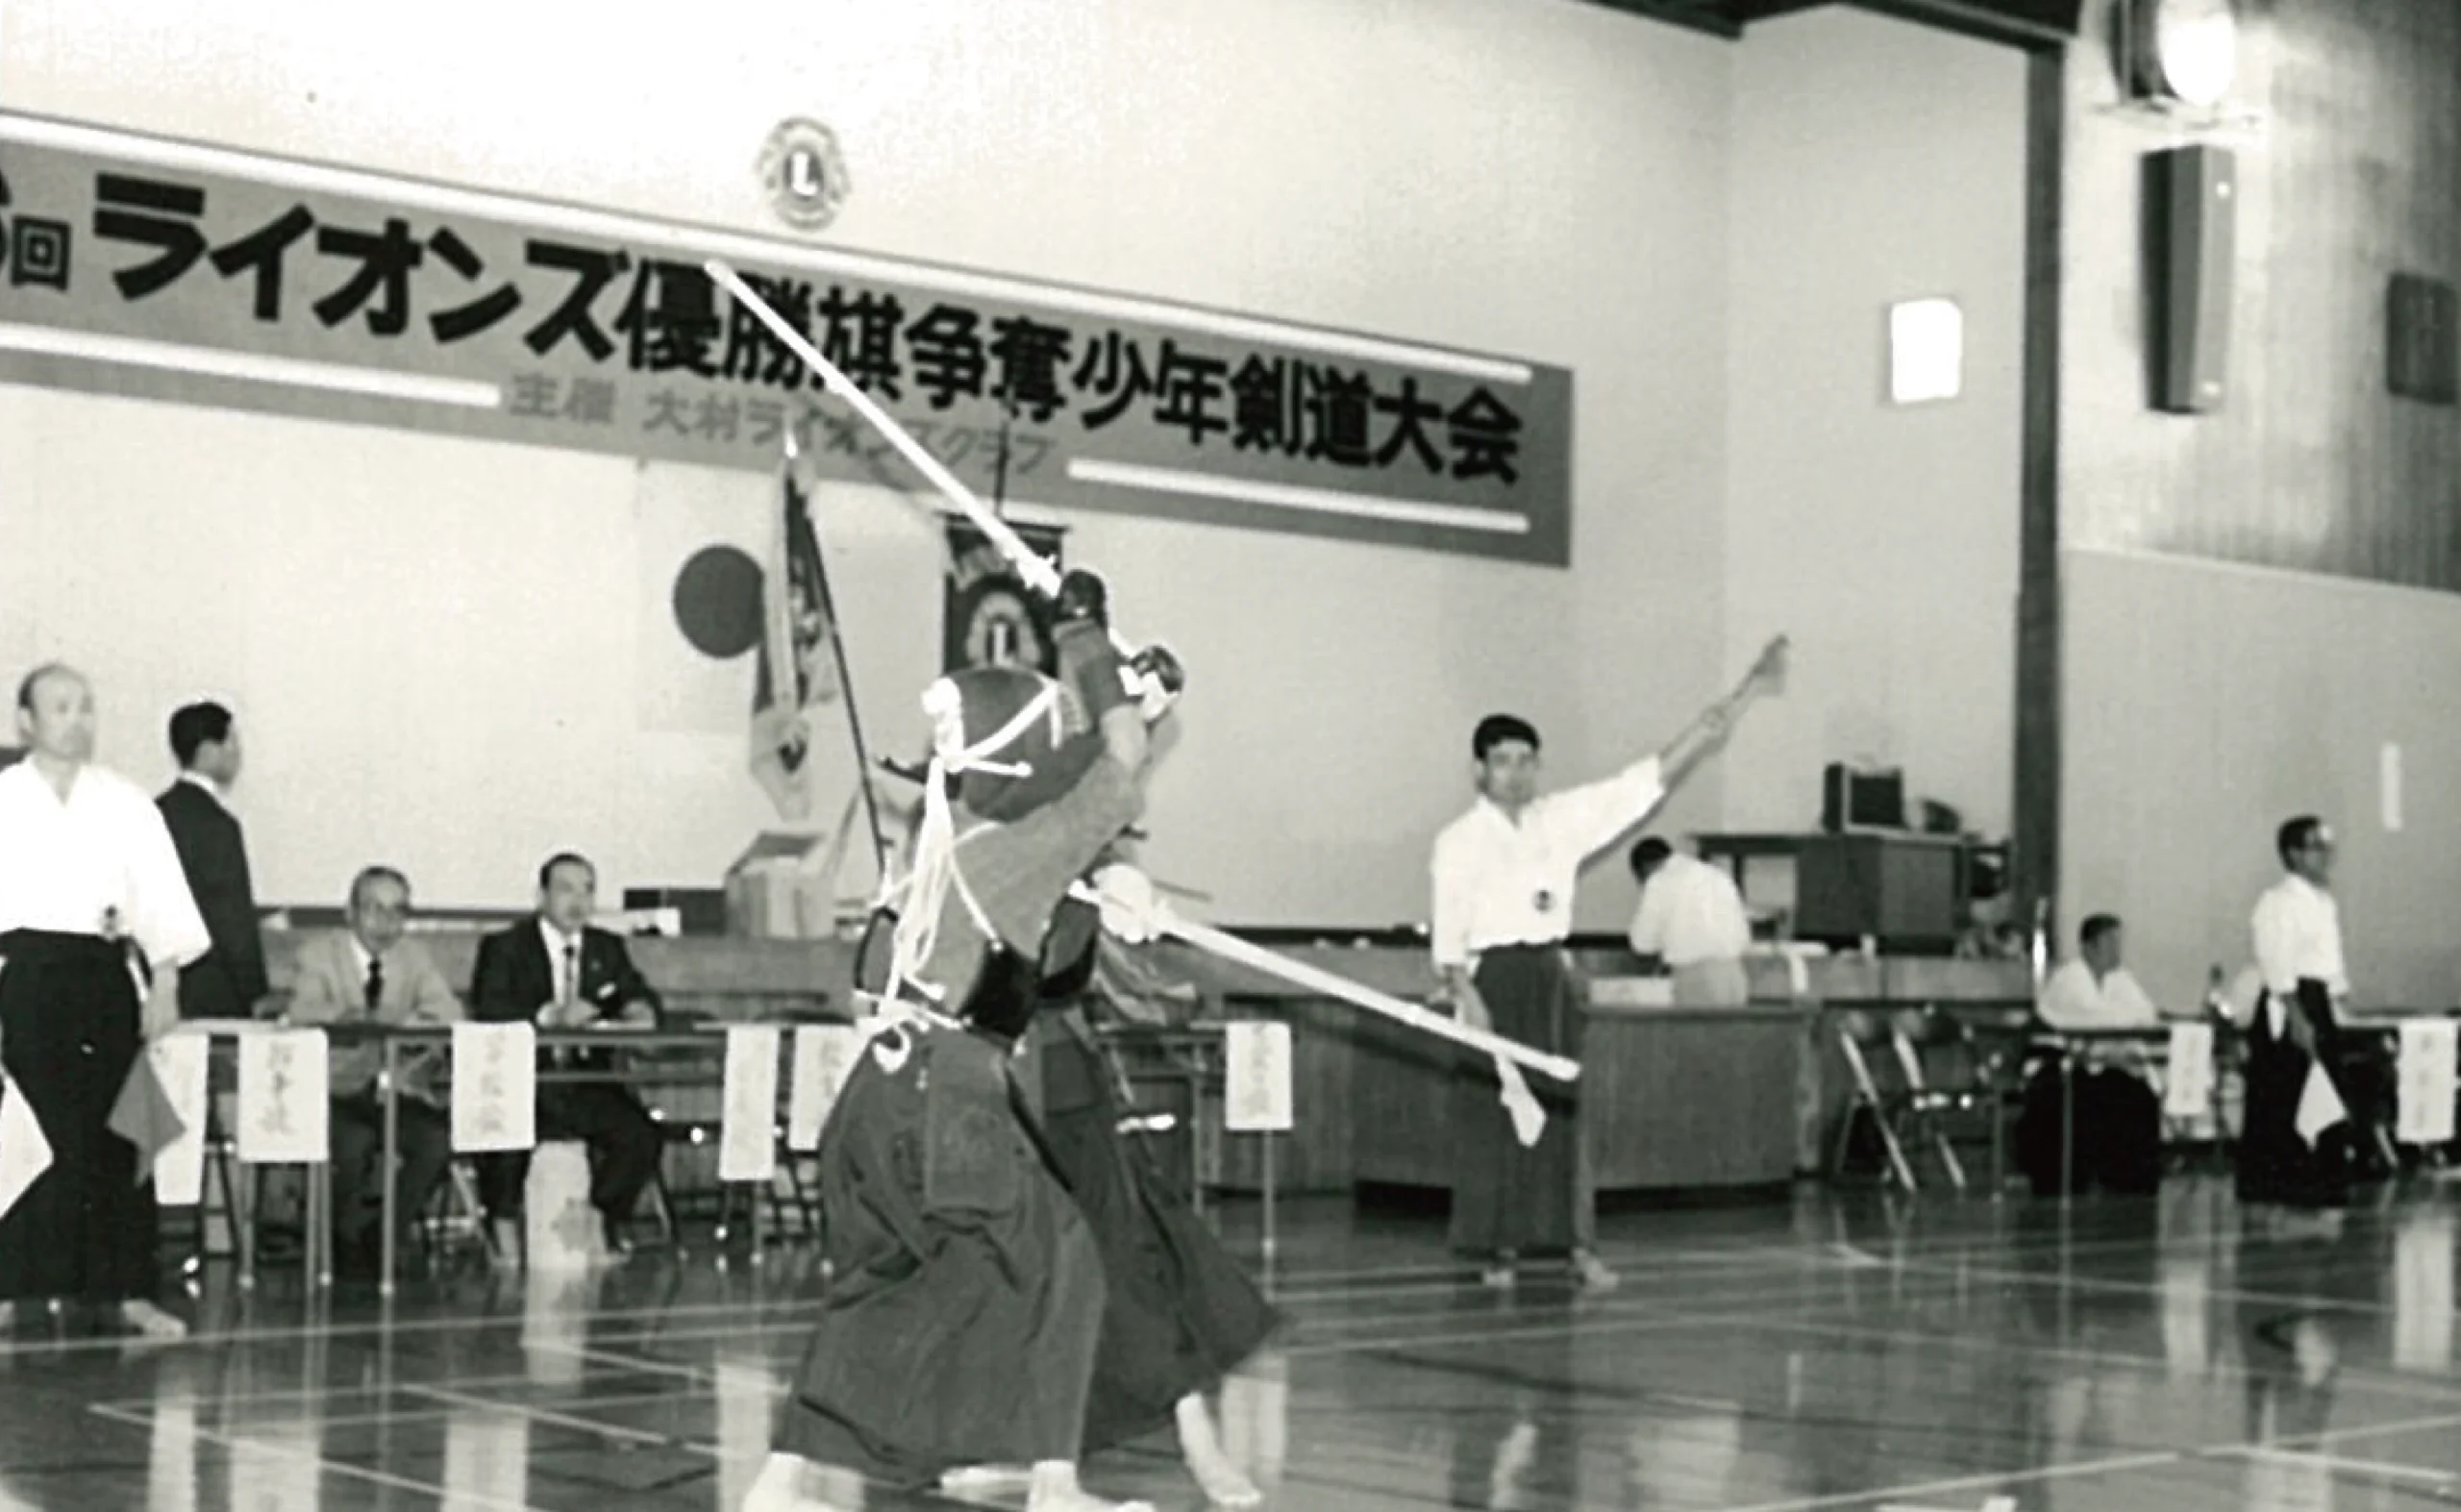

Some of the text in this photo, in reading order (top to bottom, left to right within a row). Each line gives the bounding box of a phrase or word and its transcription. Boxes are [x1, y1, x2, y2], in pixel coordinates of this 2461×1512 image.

[792, 152, 818, 195] L
[0, 169, 1523, 486] 回ライオンズ優勝旗争奪少年剣道大会
[641, 388, 1056, 475] 大村ライオズクラブ
